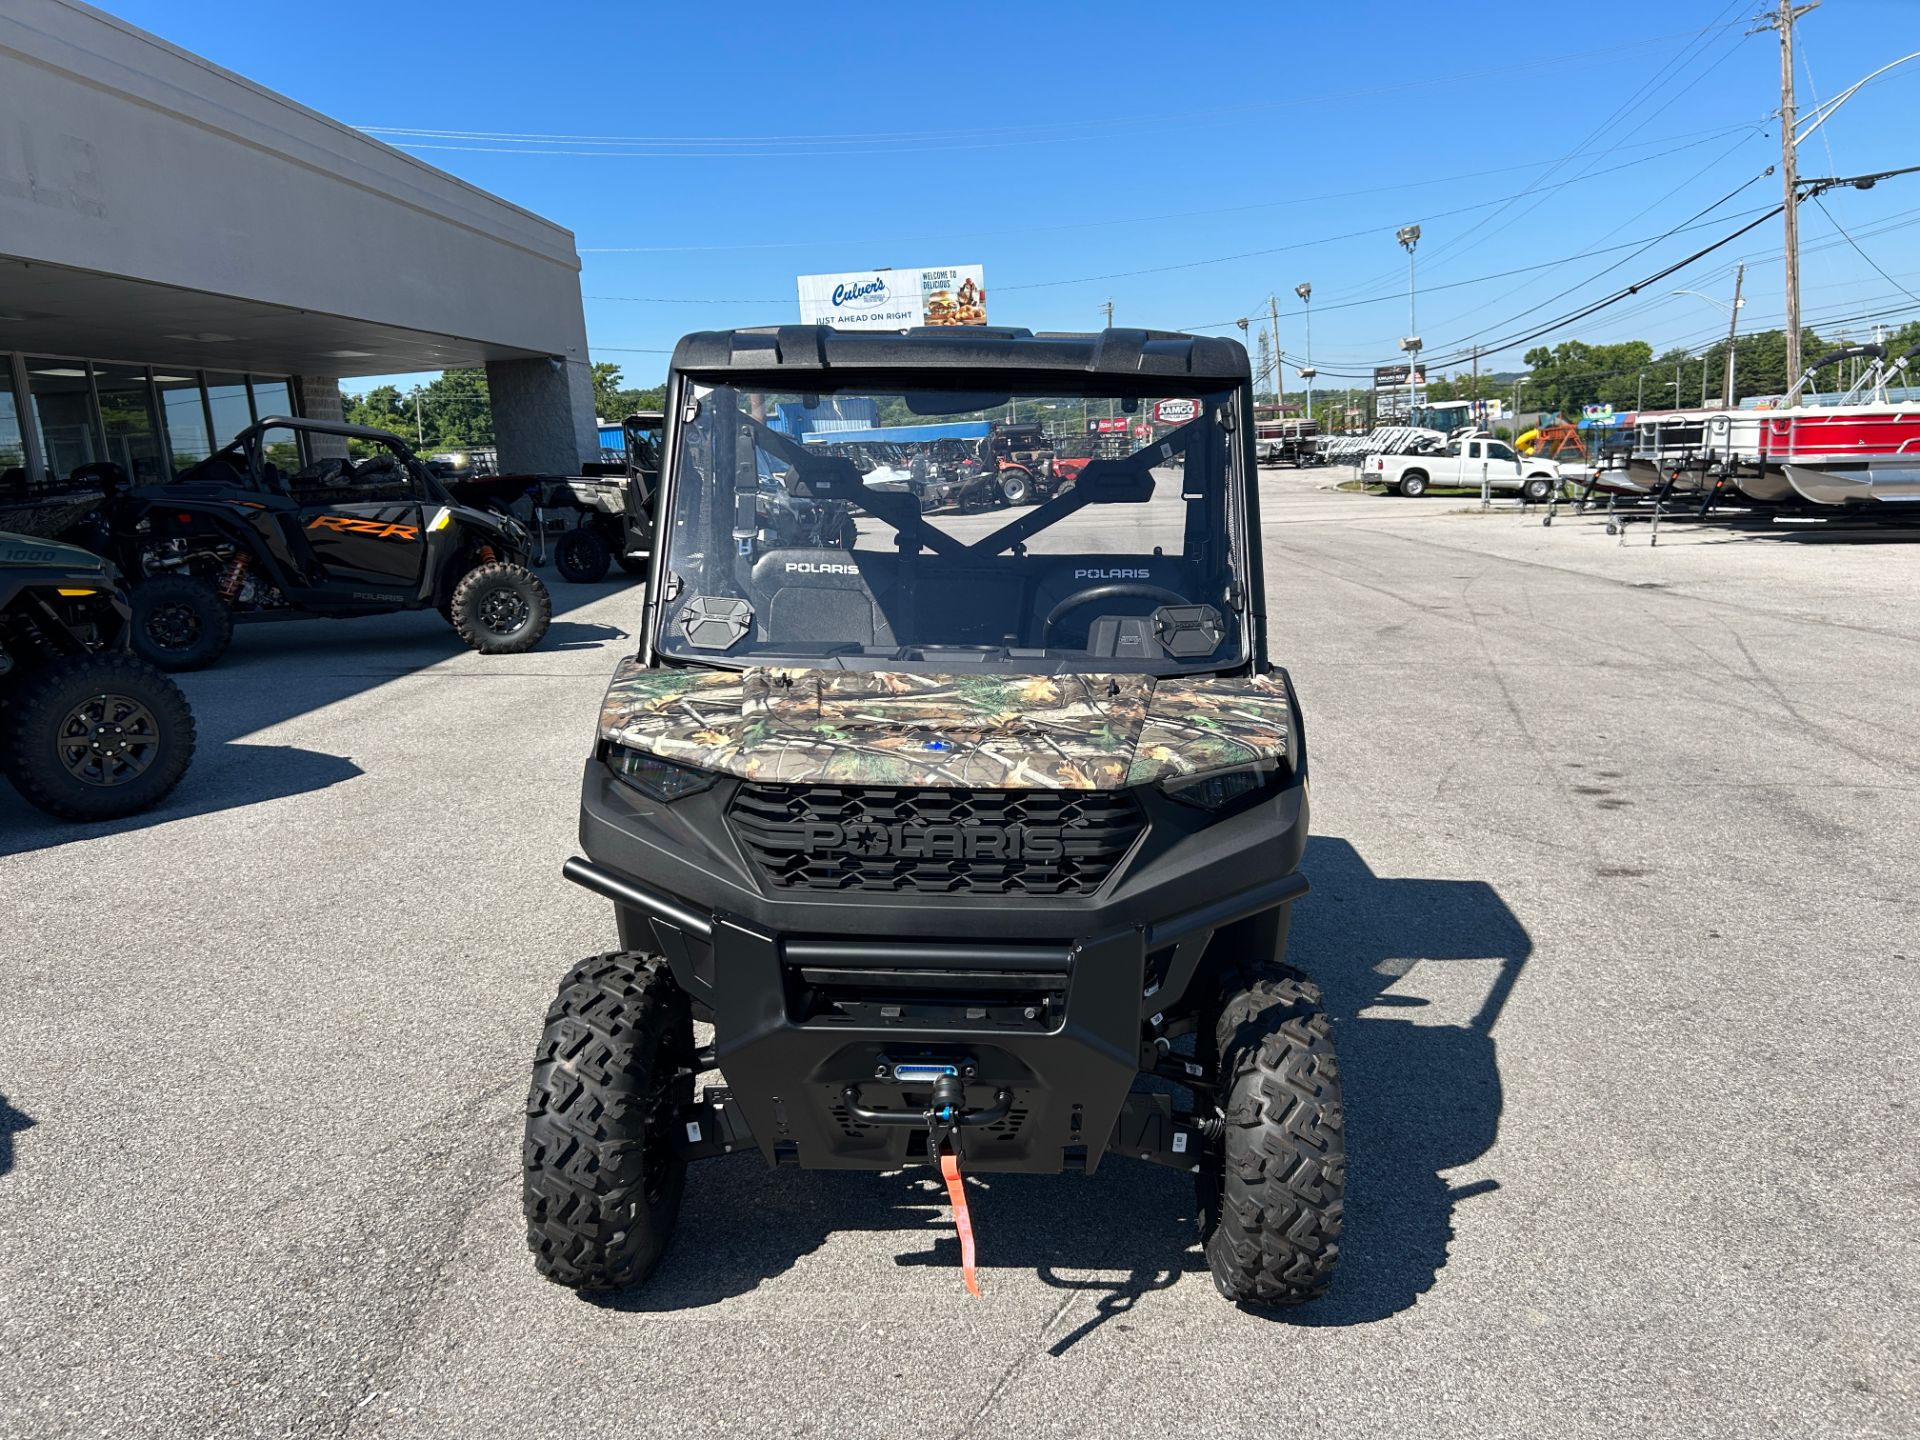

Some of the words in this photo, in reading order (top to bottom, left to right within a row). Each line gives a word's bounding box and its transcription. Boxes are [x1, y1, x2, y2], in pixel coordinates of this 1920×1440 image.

[922, 271, 949, 280] WELCOME
[949, 270, 957, 279] TO
[923, 280, 951, 290] DELICIOUS
[832, 277, 886, 306] Culver's
[816, 317, 836, 326] JUST
[837, 312, 868, 323] AHEAD
[870, 313, 884, 321] ON
[886, 311, 913, 320] RIGHT
[1158, 405, 1195, 414] AAMCO
[307, 515, 419, 540] RZR
[5, 550, 57, 561] 1000
[785, 562, 860, 575] POLARIS
[1074, 568, 1150, 579] POLARIS
[353, 591, 405, 601] POLARIS
[803, 821, 1066, 861] POLARIS
